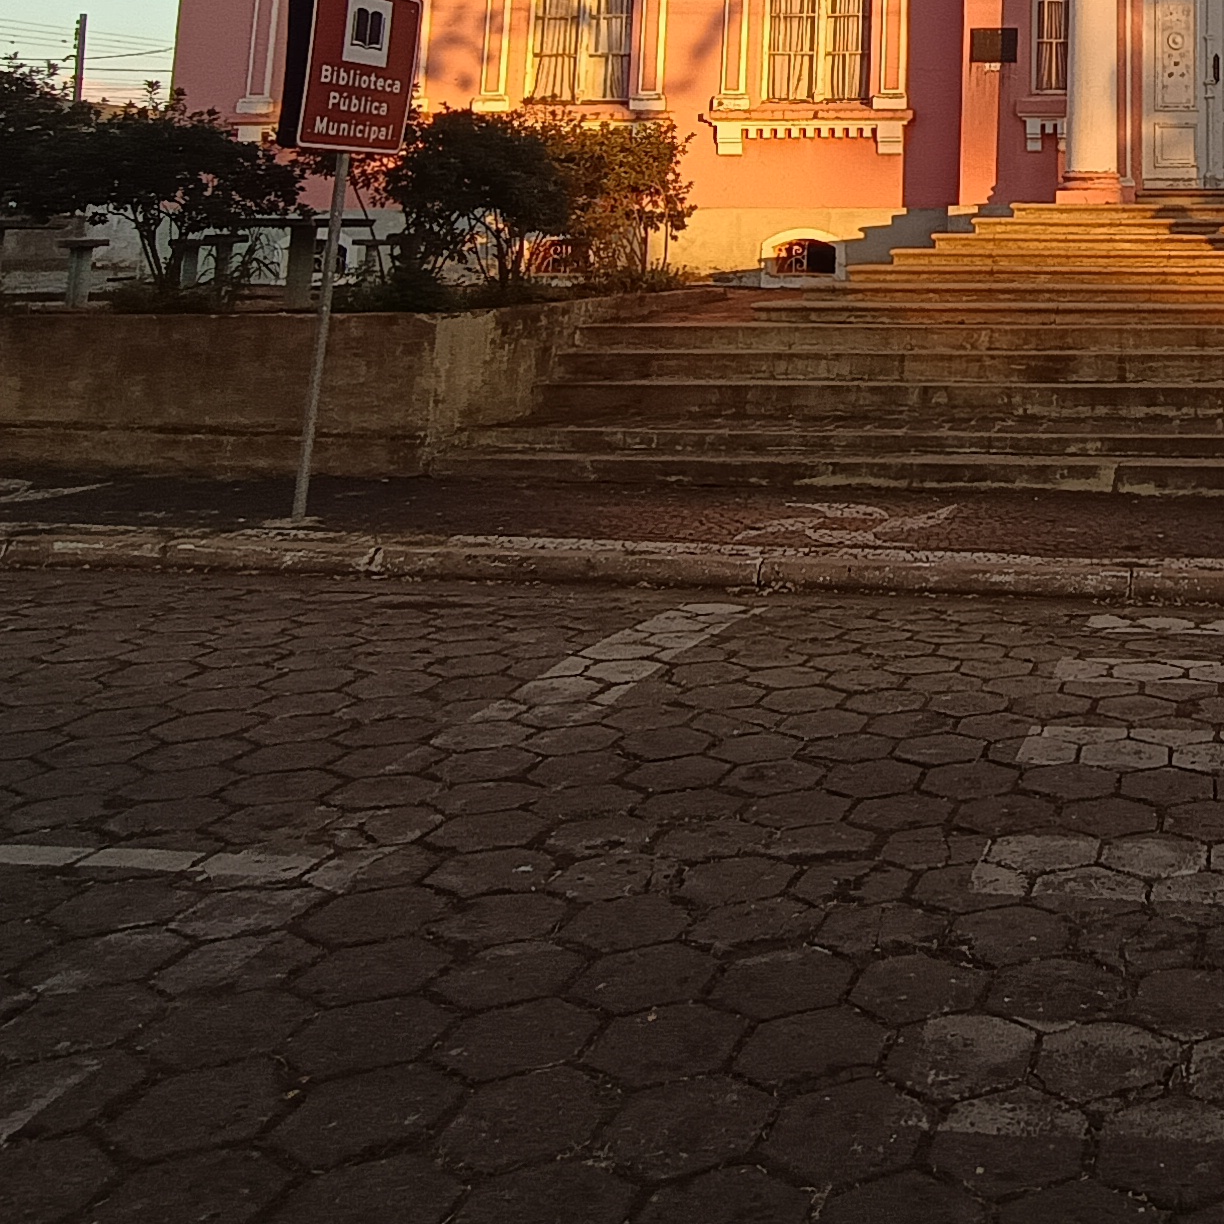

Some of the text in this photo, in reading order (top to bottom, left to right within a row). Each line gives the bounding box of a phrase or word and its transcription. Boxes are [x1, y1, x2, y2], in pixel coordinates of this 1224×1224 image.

[320, 64, 401, 93] Biblioteca
[328, 91, 388, 116] Pública
[314, 115, 394, 143] Municipal
